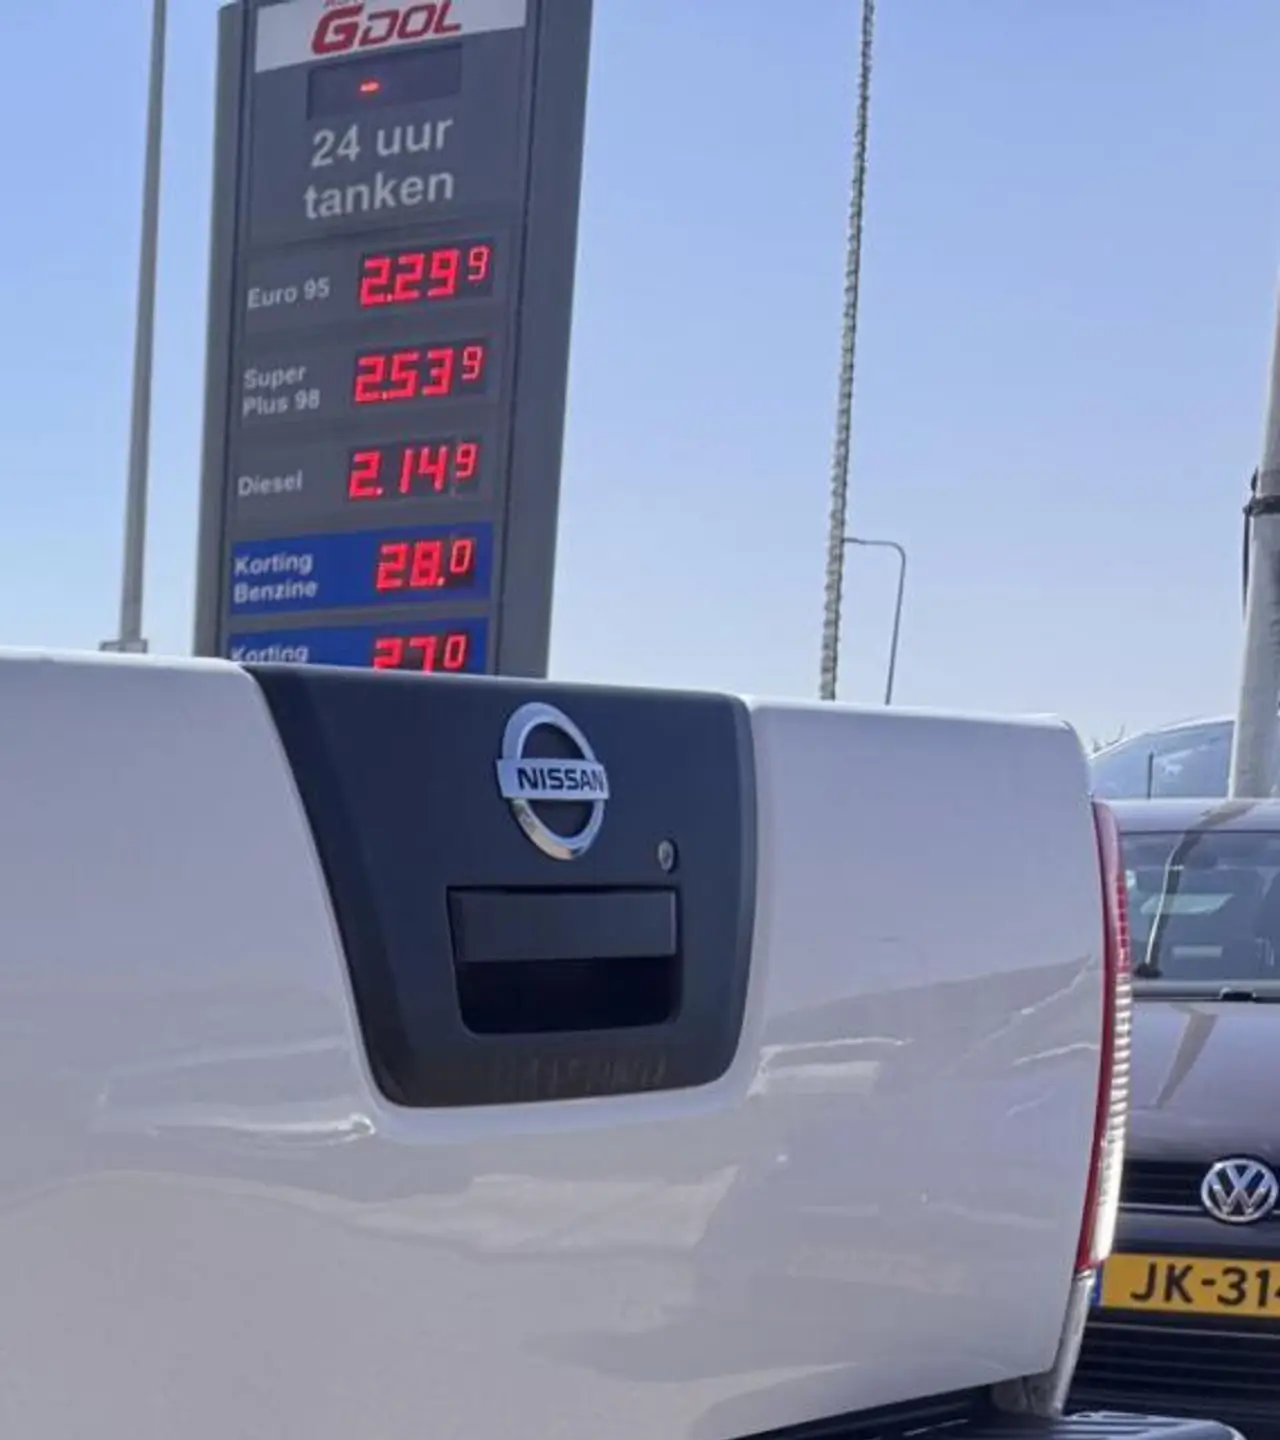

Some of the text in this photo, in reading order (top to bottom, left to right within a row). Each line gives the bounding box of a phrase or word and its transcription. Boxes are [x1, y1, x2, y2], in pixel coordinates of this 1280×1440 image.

[311, 118, 454, 168] 24 uur
[304, 172, 454, 220] tanken
[247, 277, 330, 310] Euro 95
[243, 364, 307, 392] Super
[242, 388, 320, 418] Plus 98
[237, 470, 303, 497] Diesel
[234, 551, 314, 582] Korting
[233, 578, 318, 604] Benzine
[516, 766, 605, 794] NISSAN
[1129, 1262, 1280, 1309] JK-31
